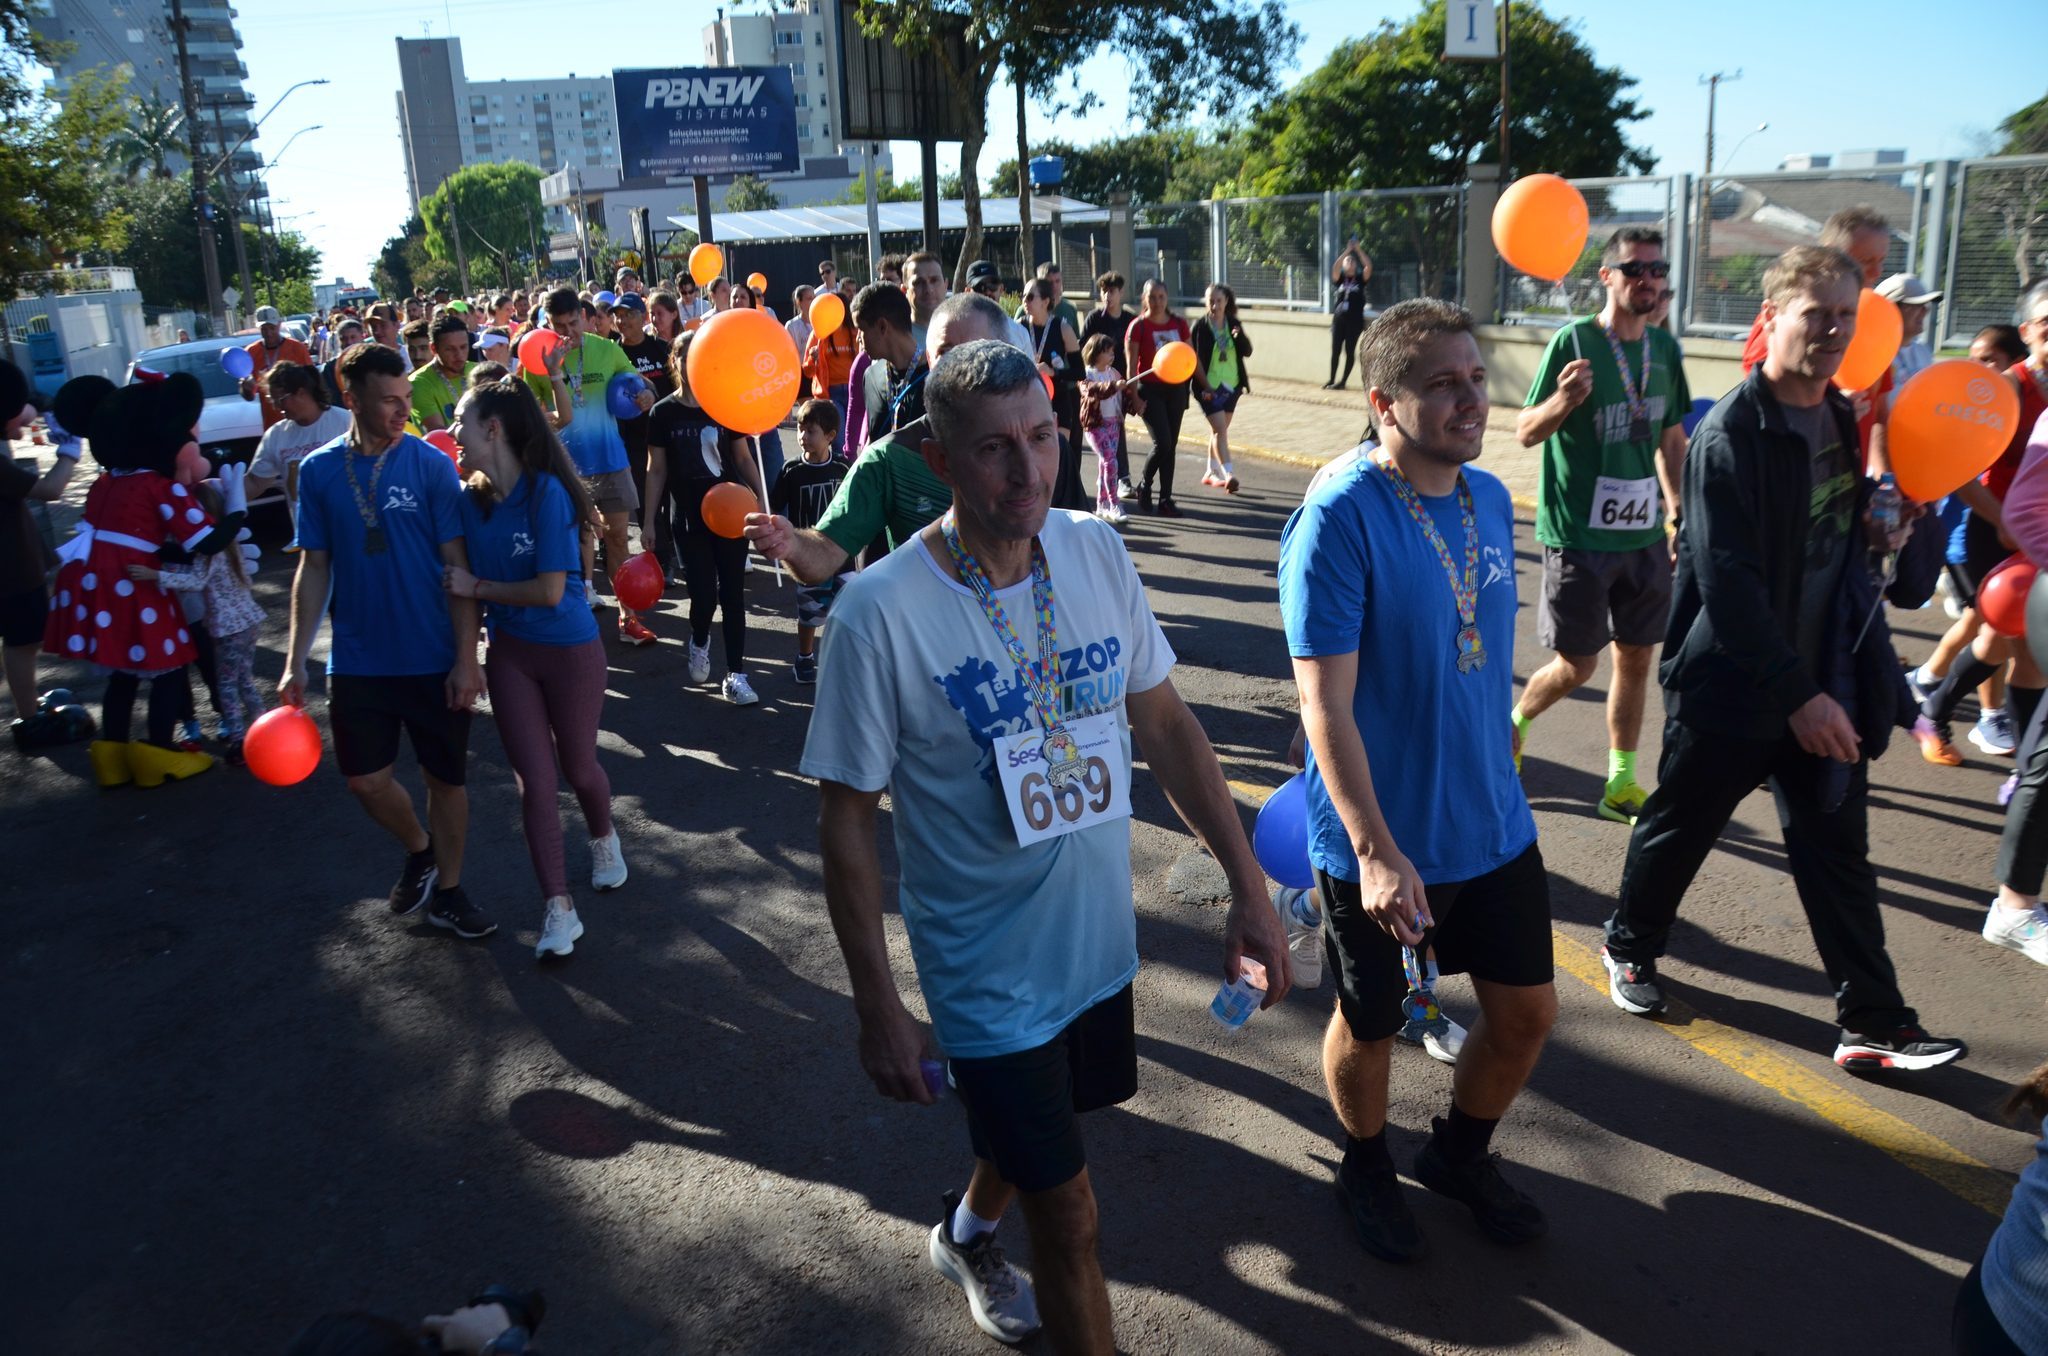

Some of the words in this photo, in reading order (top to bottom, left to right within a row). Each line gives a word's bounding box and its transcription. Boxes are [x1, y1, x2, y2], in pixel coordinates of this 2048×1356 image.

[645, 76, 765, 108] PBNEW
[675, 107, 768, 120] SISTEMAS
[669, 129, 701, 138] Soluções
[703, 126, 749, 137] tecnológicas
[682, 137, 714, 146] produtos
[1602, 498, 1649, 525] 644
[1021, 755, 1111, 831] 669
